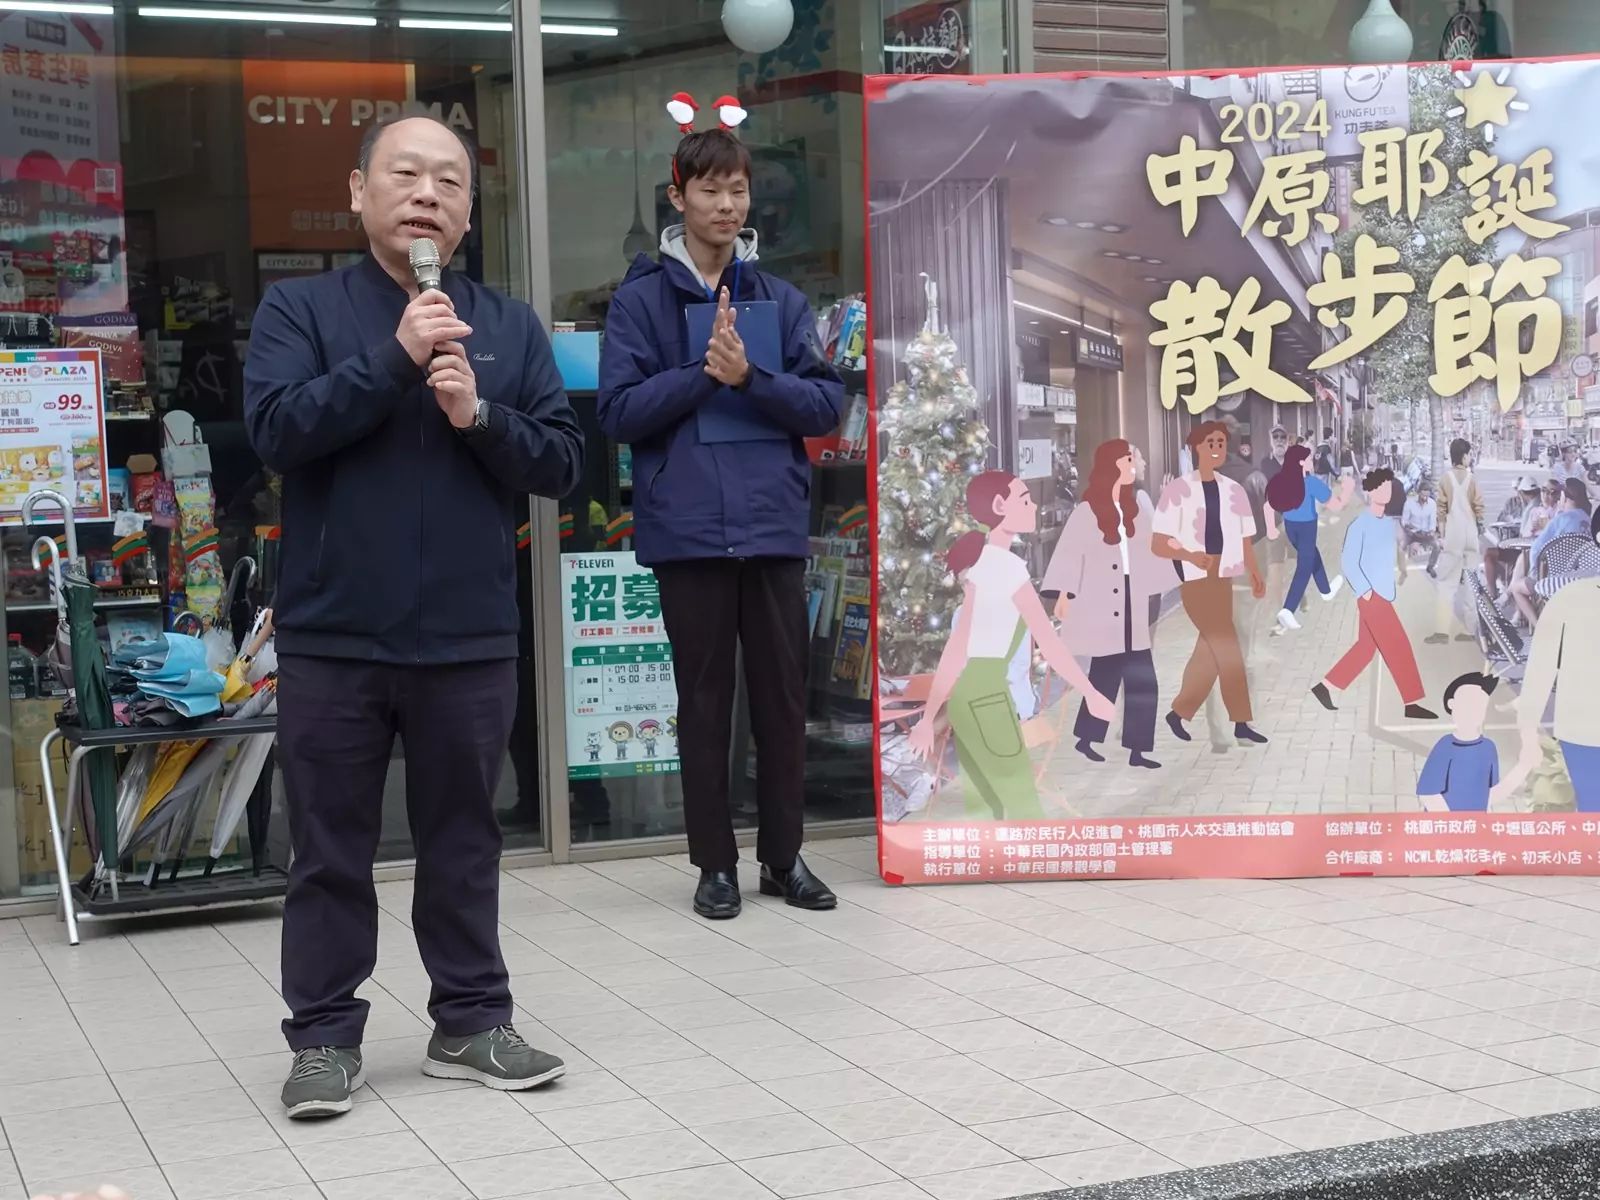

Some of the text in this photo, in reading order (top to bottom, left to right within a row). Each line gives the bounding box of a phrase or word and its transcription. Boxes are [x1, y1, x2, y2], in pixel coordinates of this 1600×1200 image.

[248, 95, 338, 125] CITY
[1219, 98, 1331, 144] 2024
[1334, 108, 1362, 119] KUNG
[1363, 107, 1376, 117] FU
[1146, 127, 1571, 247] 中原耶誕
[94, 315, 135, 325] GODIVA
[1148, 234, 1564, 415] 散步節
[89, 341, 123, 353] GODIVA
[44, 366, 87, 376] PLAZA
[58, 394, 82, 410] 99
[571, 573, 661, 622] 招募
